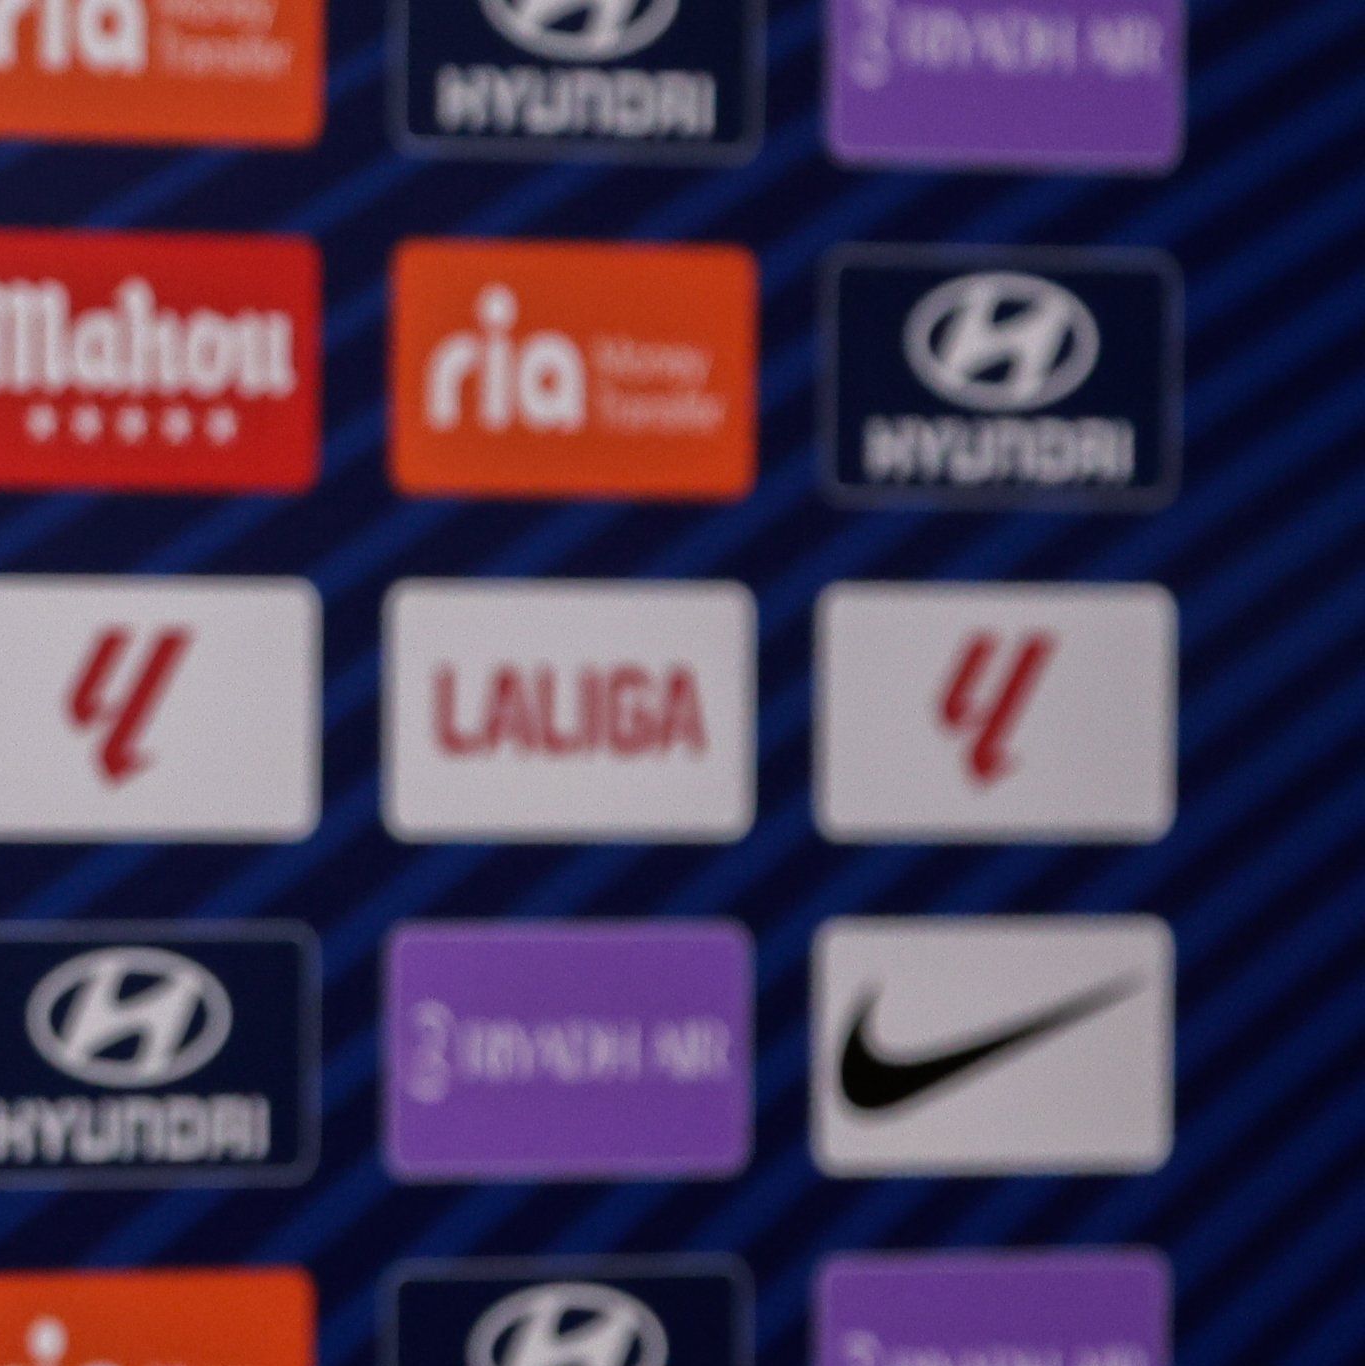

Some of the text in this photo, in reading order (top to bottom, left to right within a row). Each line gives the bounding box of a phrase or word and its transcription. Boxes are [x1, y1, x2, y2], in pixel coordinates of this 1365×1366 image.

[439, 70, 713, 135] HYUNDAI
[427, 287, 586, 430] ria
[866, 419, 1132, 483] HYUNDAI
[433, 664, 708, 759] LALIGA
